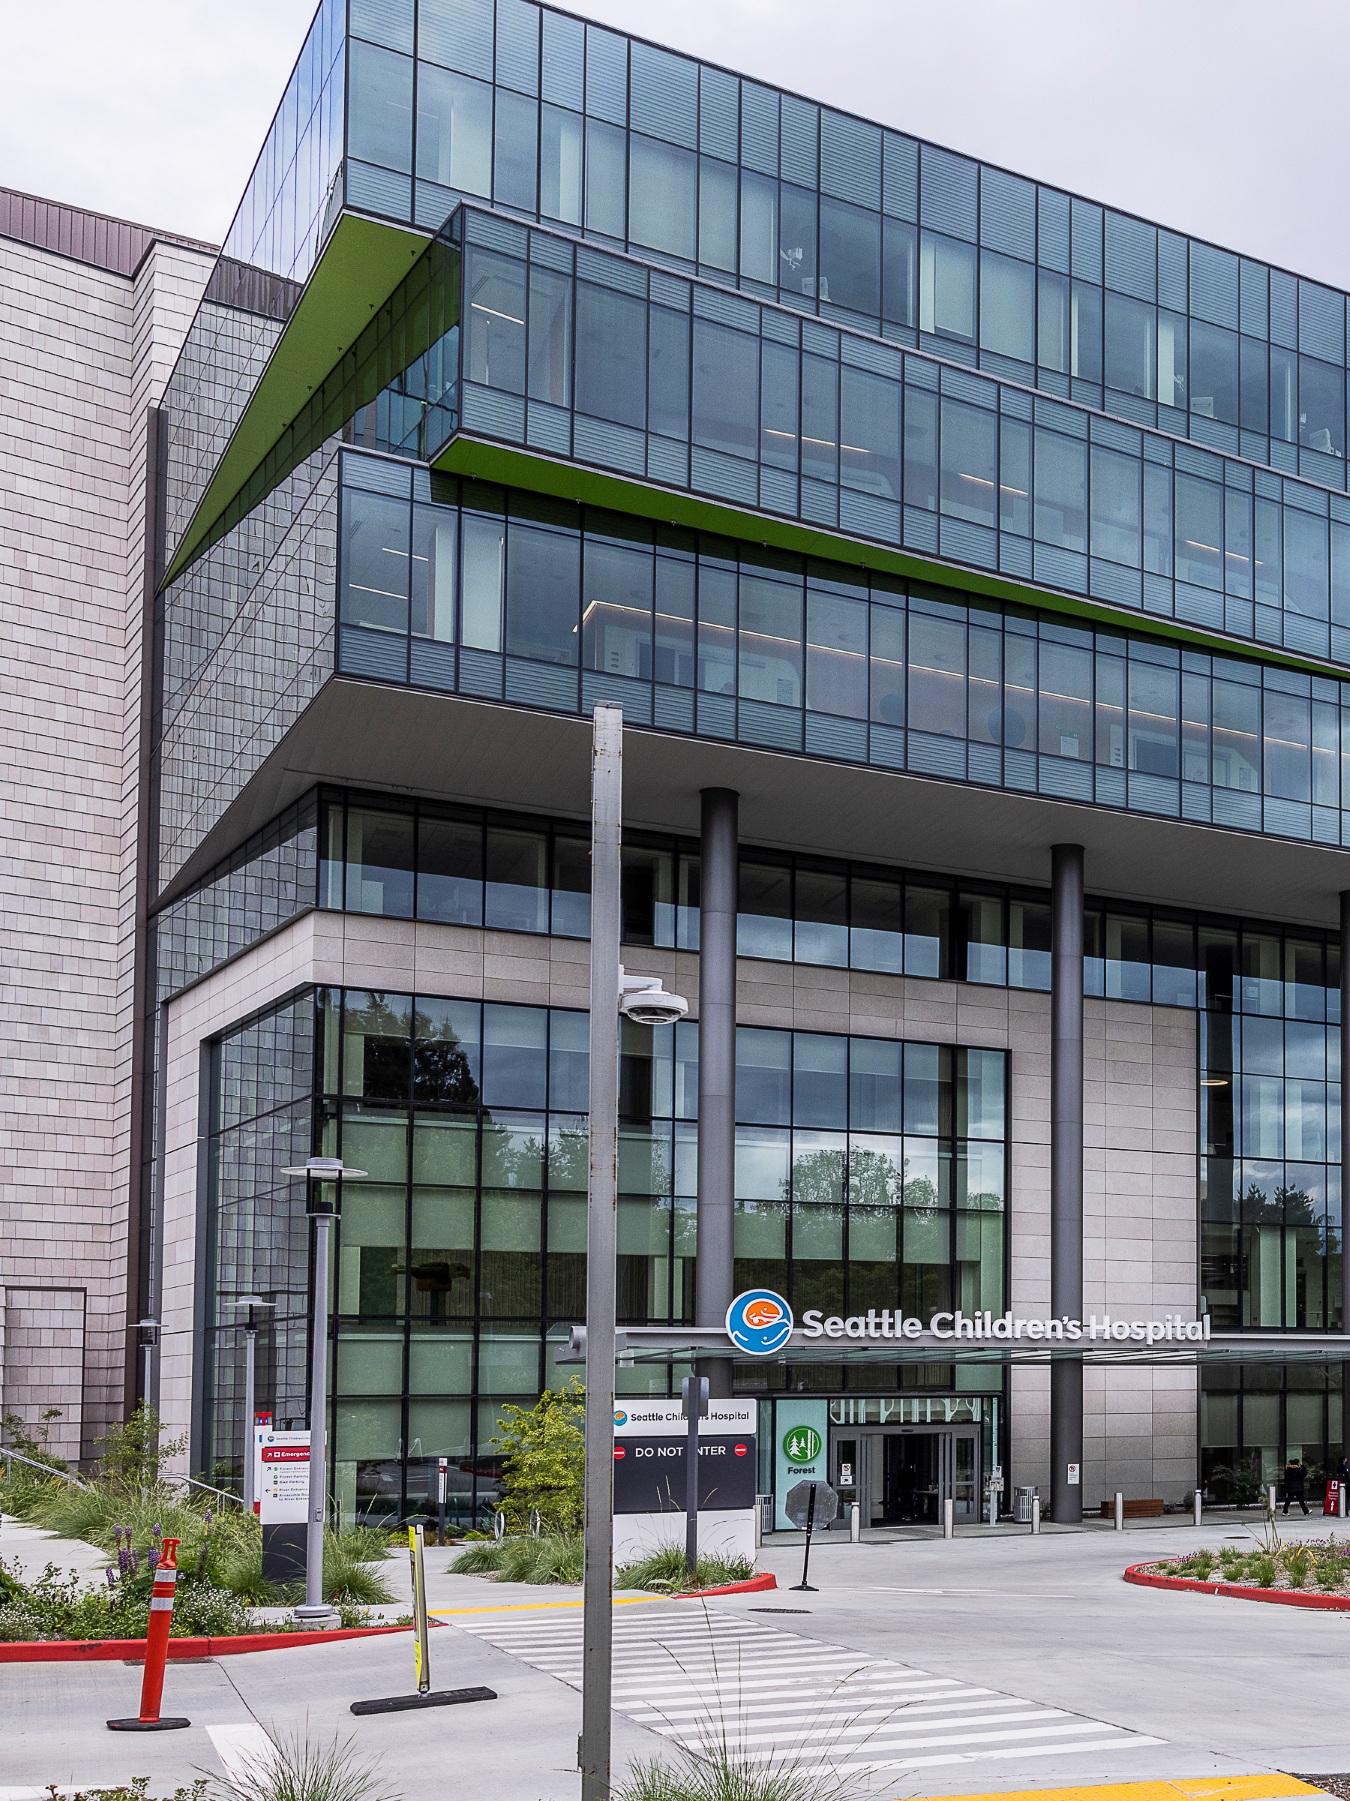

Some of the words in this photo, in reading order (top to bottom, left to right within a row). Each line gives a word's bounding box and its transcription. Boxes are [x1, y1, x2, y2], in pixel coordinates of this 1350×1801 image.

[802, 1309, 923, 1339] Seattle
[930, 1310, 1082, 1341] Children's
[1089, 1314, 1211, 1346] Hospital
[630, 1413, 663, 1422] Seattle
[711, 1411, 749, 1421] Hospital
[635, 1447, 655, 1458] DO
[657, 1447, 684, 1457] NOT
[697, 1446, 726, 1456] NTER
[787, 1466, 816, 1475] Forest
